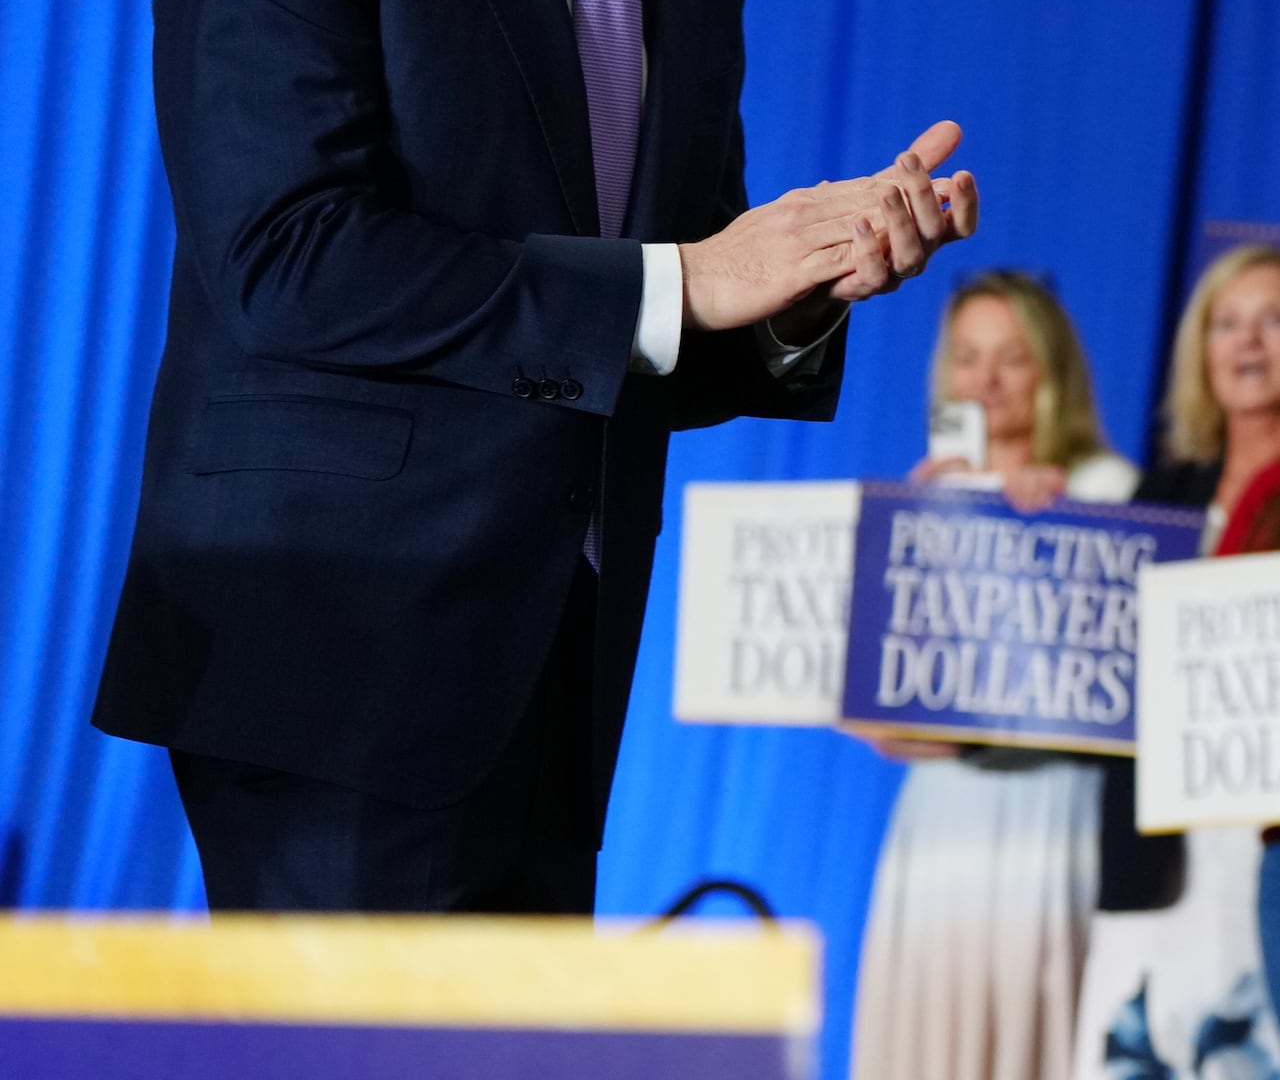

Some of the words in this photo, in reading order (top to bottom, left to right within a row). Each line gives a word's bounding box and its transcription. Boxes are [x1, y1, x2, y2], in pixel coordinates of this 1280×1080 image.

[889, 511, 1157, 578] PROTECTING
[886, 570, 1138, 654] TAXPAYER
[876, 637, 1136, 724] DOLLARS
